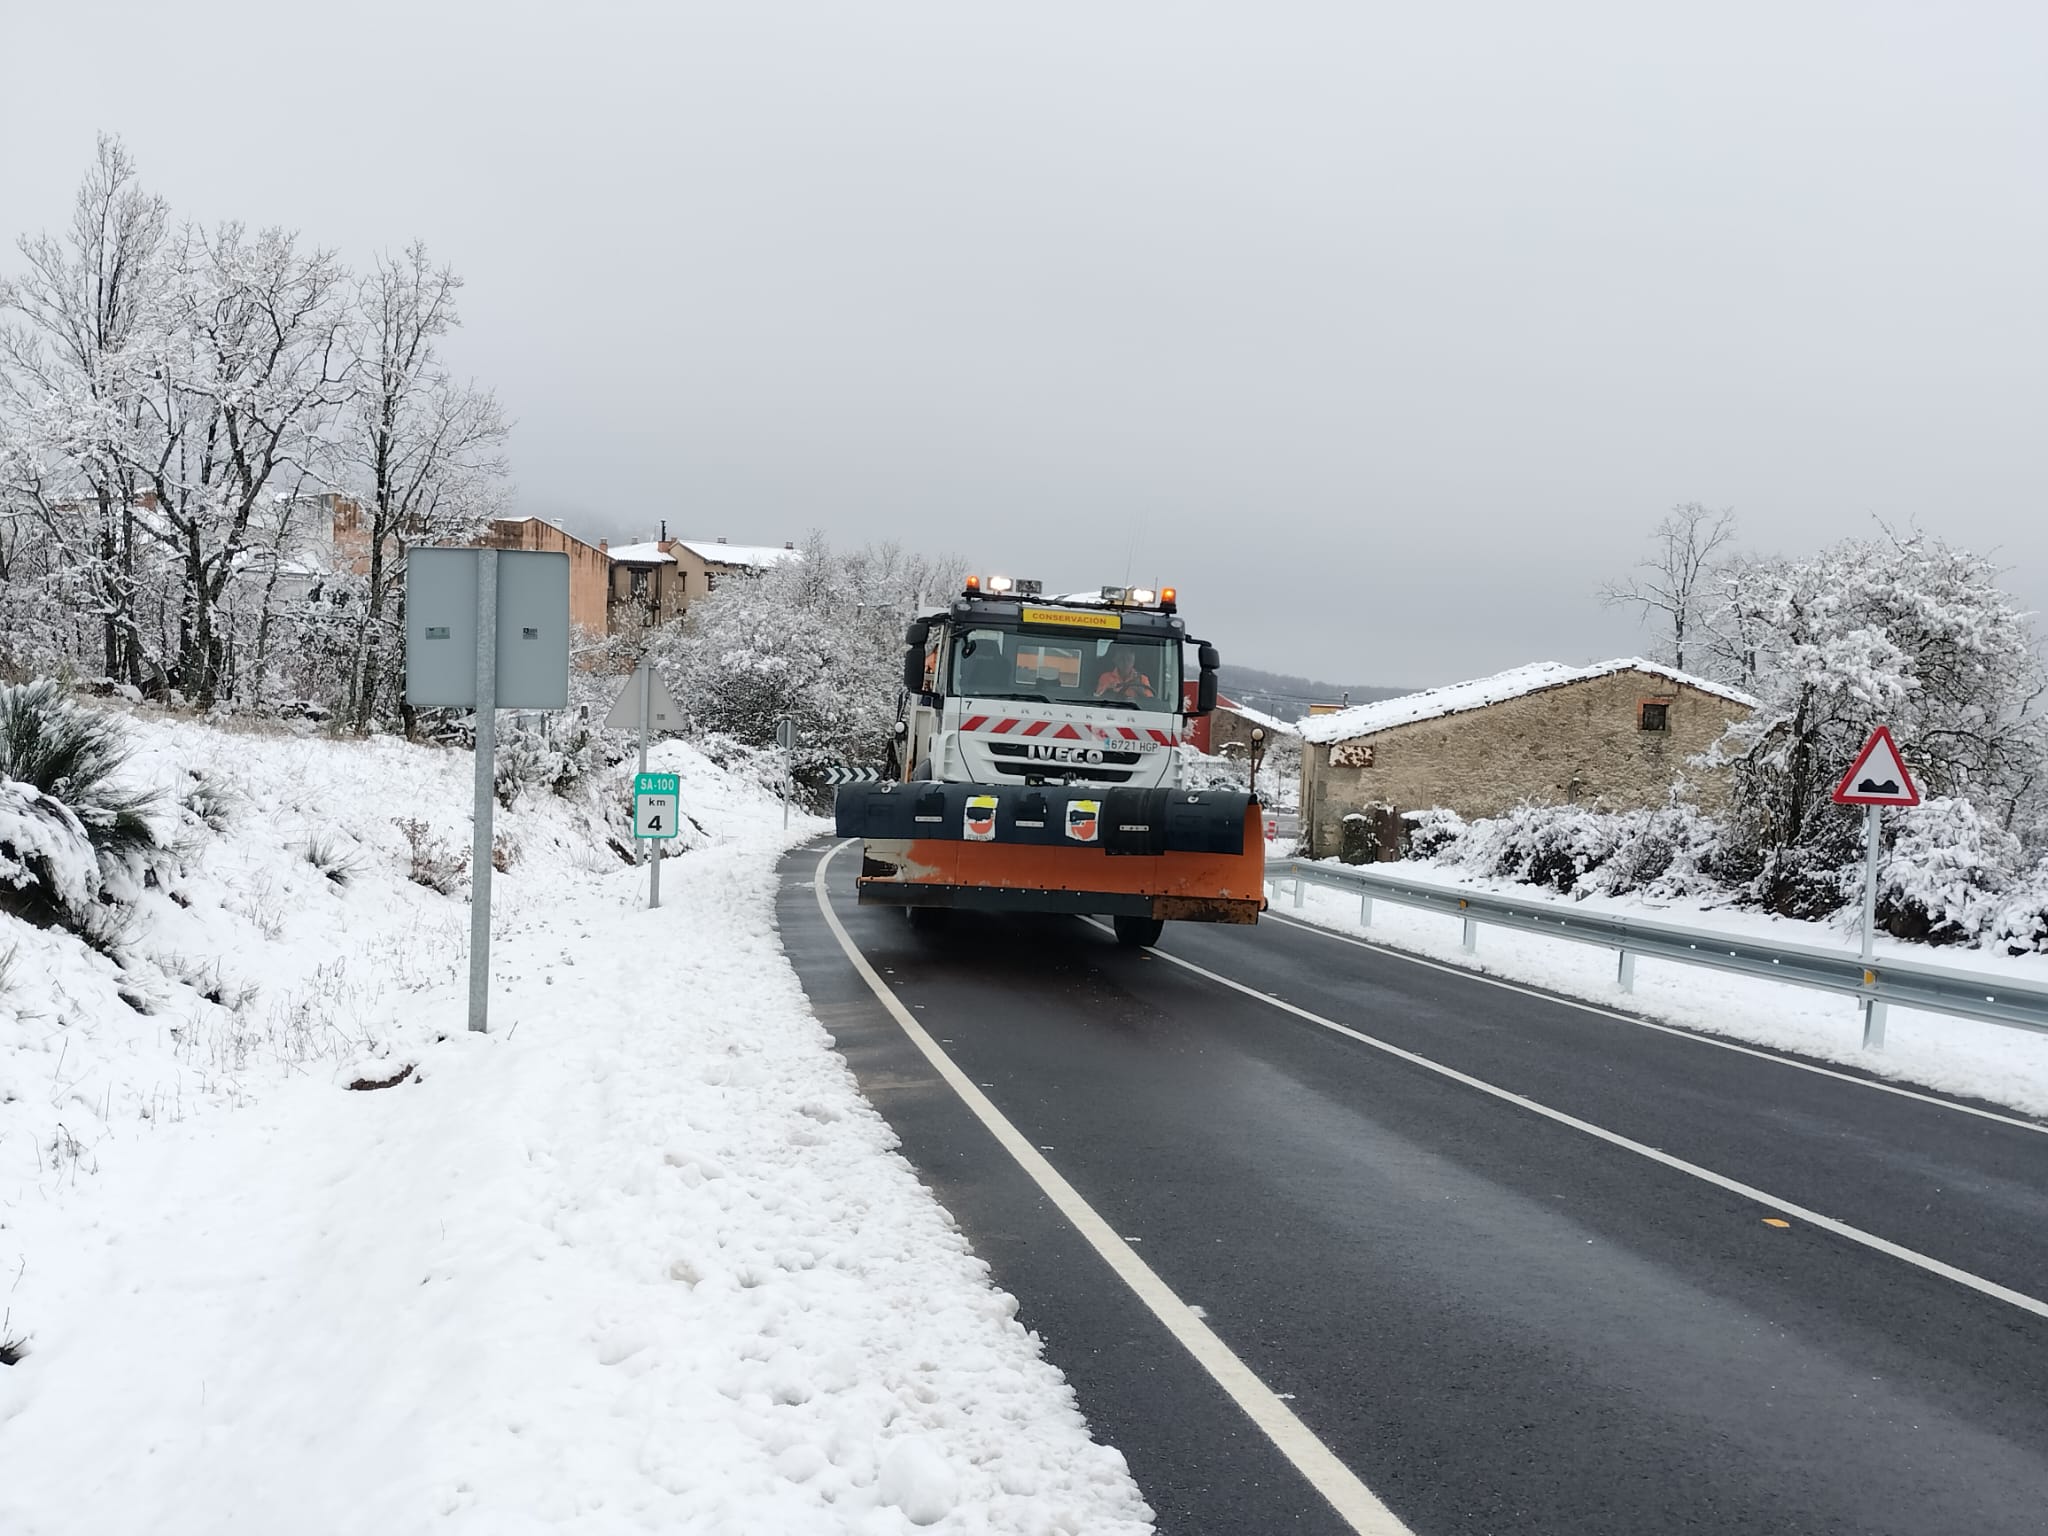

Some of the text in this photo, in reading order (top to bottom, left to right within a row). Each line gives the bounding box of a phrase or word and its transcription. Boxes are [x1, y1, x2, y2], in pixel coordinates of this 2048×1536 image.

[965, 700, 973, 710] 7
[1111, 739, 1158, 753] 6721 HGP
[1026, 744, 1104, 765] IVECO
[640, 778, 675, 791] SA-100
[648, 797, 666, 807] km
[647, 815, 663, 832] 4
